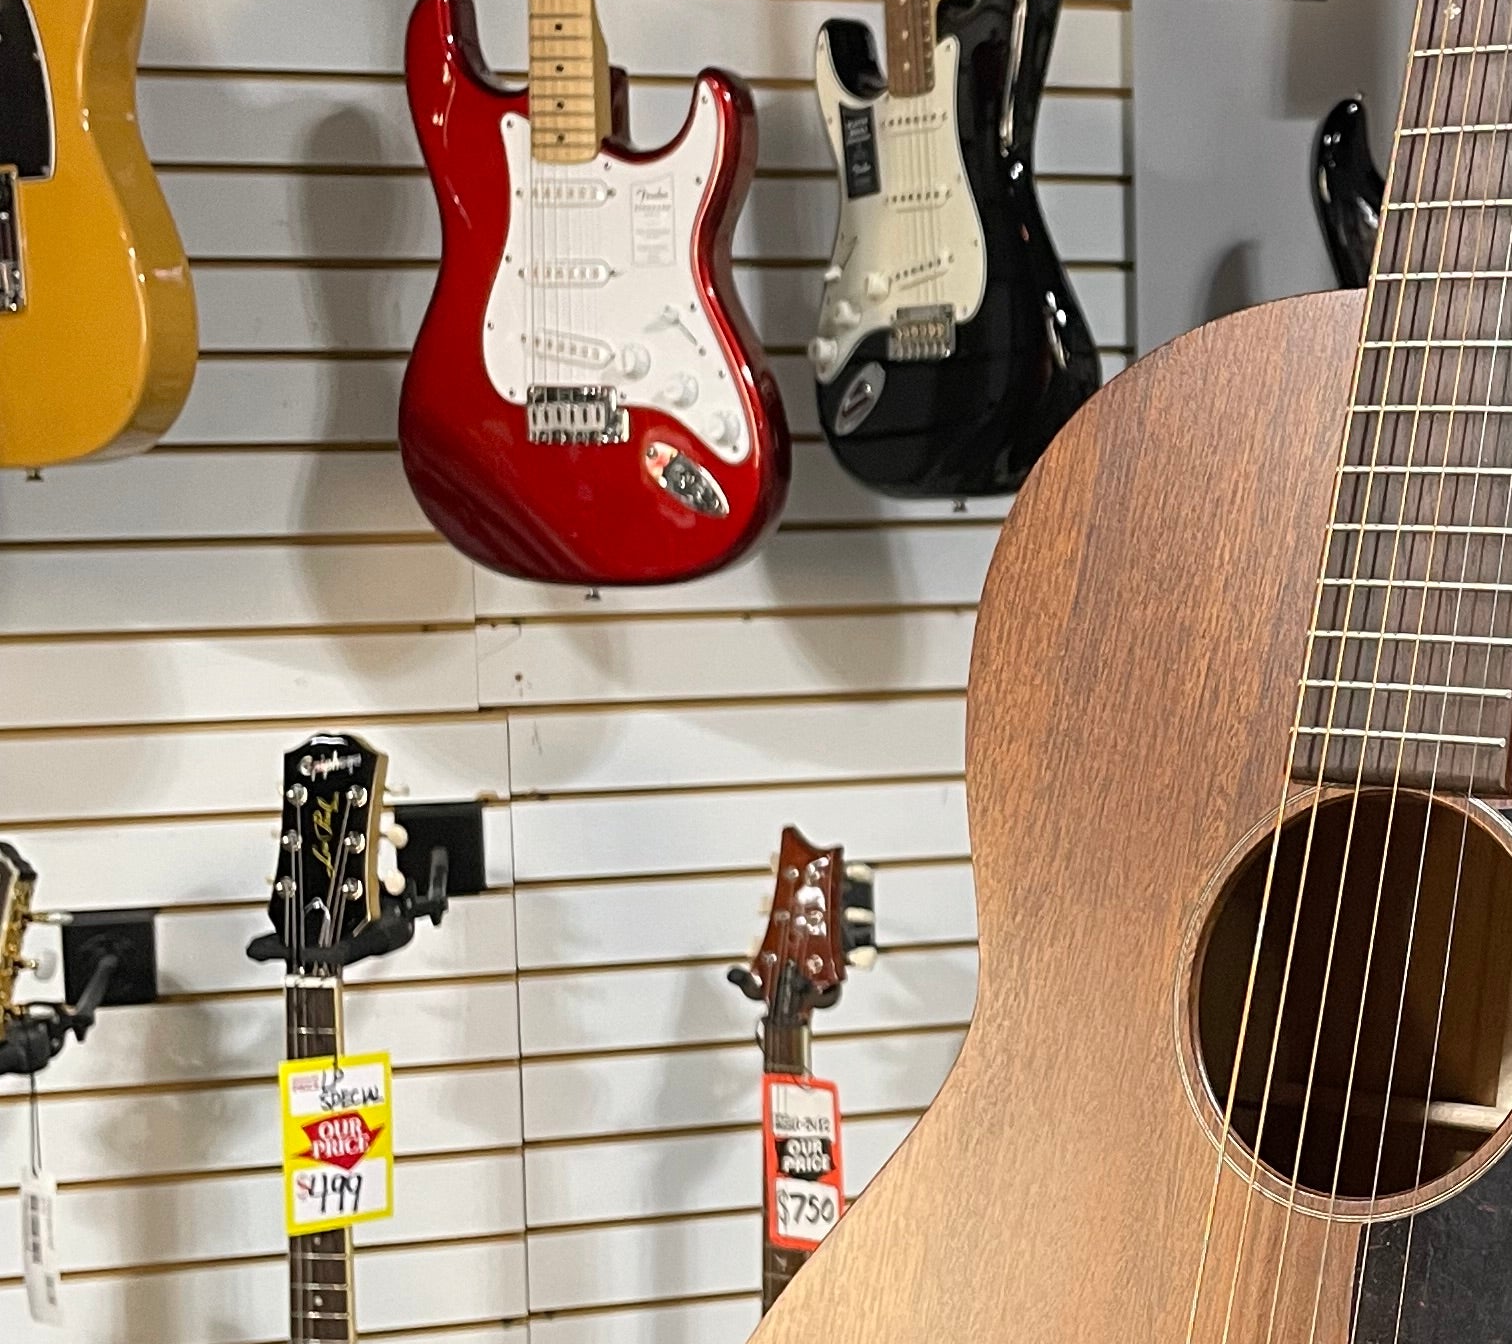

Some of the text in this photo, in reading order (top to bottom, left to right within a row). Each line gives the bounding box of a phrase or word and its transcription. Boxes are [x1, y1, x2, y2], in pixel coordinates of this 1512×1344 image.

[318, 1117, 362, 1140] OUR
[312, 1132, 371, 1160] PRICE
[786, 1138, 823, 1156] OUR
[781, 1154, 831, 1174] PRICE
[777, 1187, 836, 1226] $750
